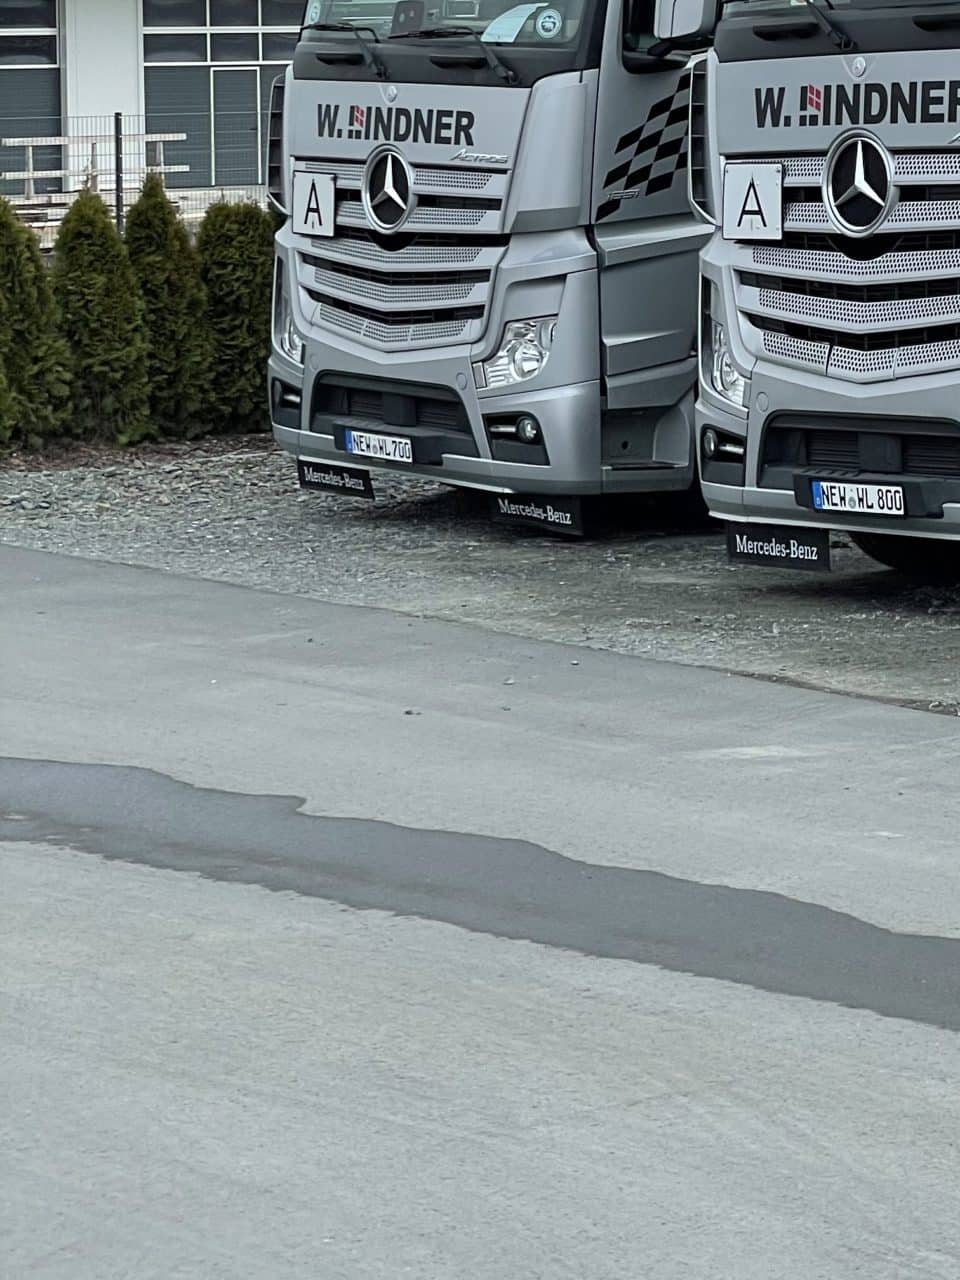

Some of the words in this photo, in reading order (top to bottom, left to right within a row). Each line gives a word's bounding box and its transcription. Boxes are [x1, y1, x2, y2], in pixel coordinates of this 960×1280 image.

[317, 103, 343, 139] W.
[755, 86, 792, 129] W.
[303, 179, 323, 227] A
[736, 176, 768, 228] A
[351, 433, 372, 454] NEW
[377, 438, 391, 456] WL
[391, 440, 411, 460] 700
[303, 465, 365, 491] Mercedes-Benz
[497, 497, 573, 525] Mercedes-Benz
[821, 483, 847, 508] NEW
[856, 487, 874, 510] WL
[877, 488, 903, 512] 800
[735, 533, 819, 561] Mercedes-Benz
